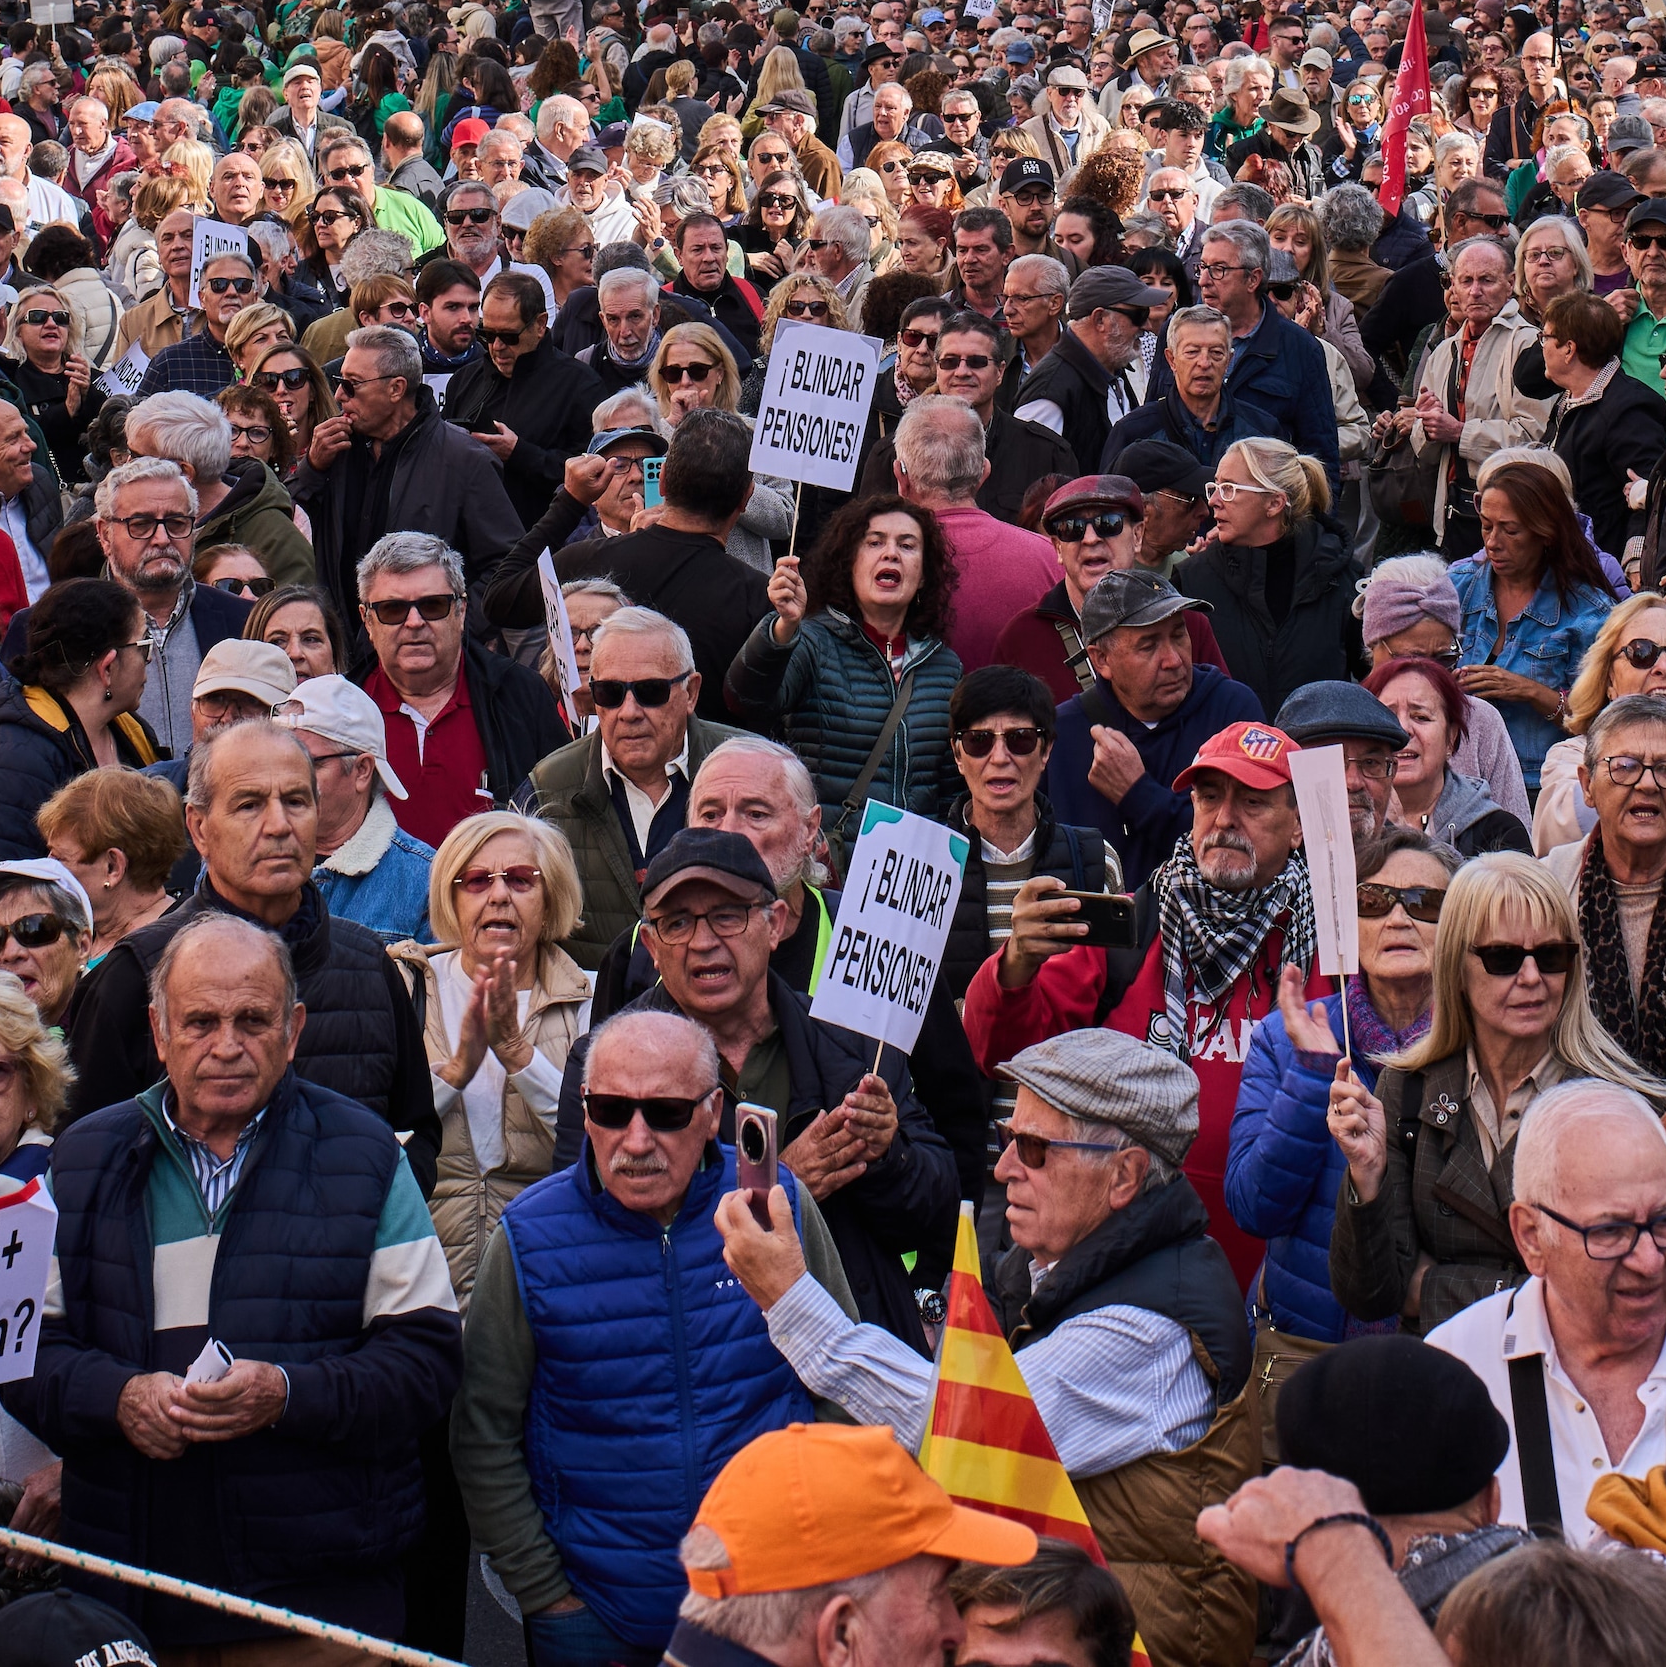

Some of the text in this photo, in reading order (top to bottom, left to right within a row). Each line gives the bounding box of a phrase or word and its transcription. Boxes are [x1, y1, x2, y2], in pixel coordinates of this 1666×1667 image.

[790, 349, 865, 403] BLINDAR
[759, 407, 860, 464] PENSIONES!
[875, 847, 952, 930] BLINDAR
[828, 925, 936, 1017] PENSIONES!
